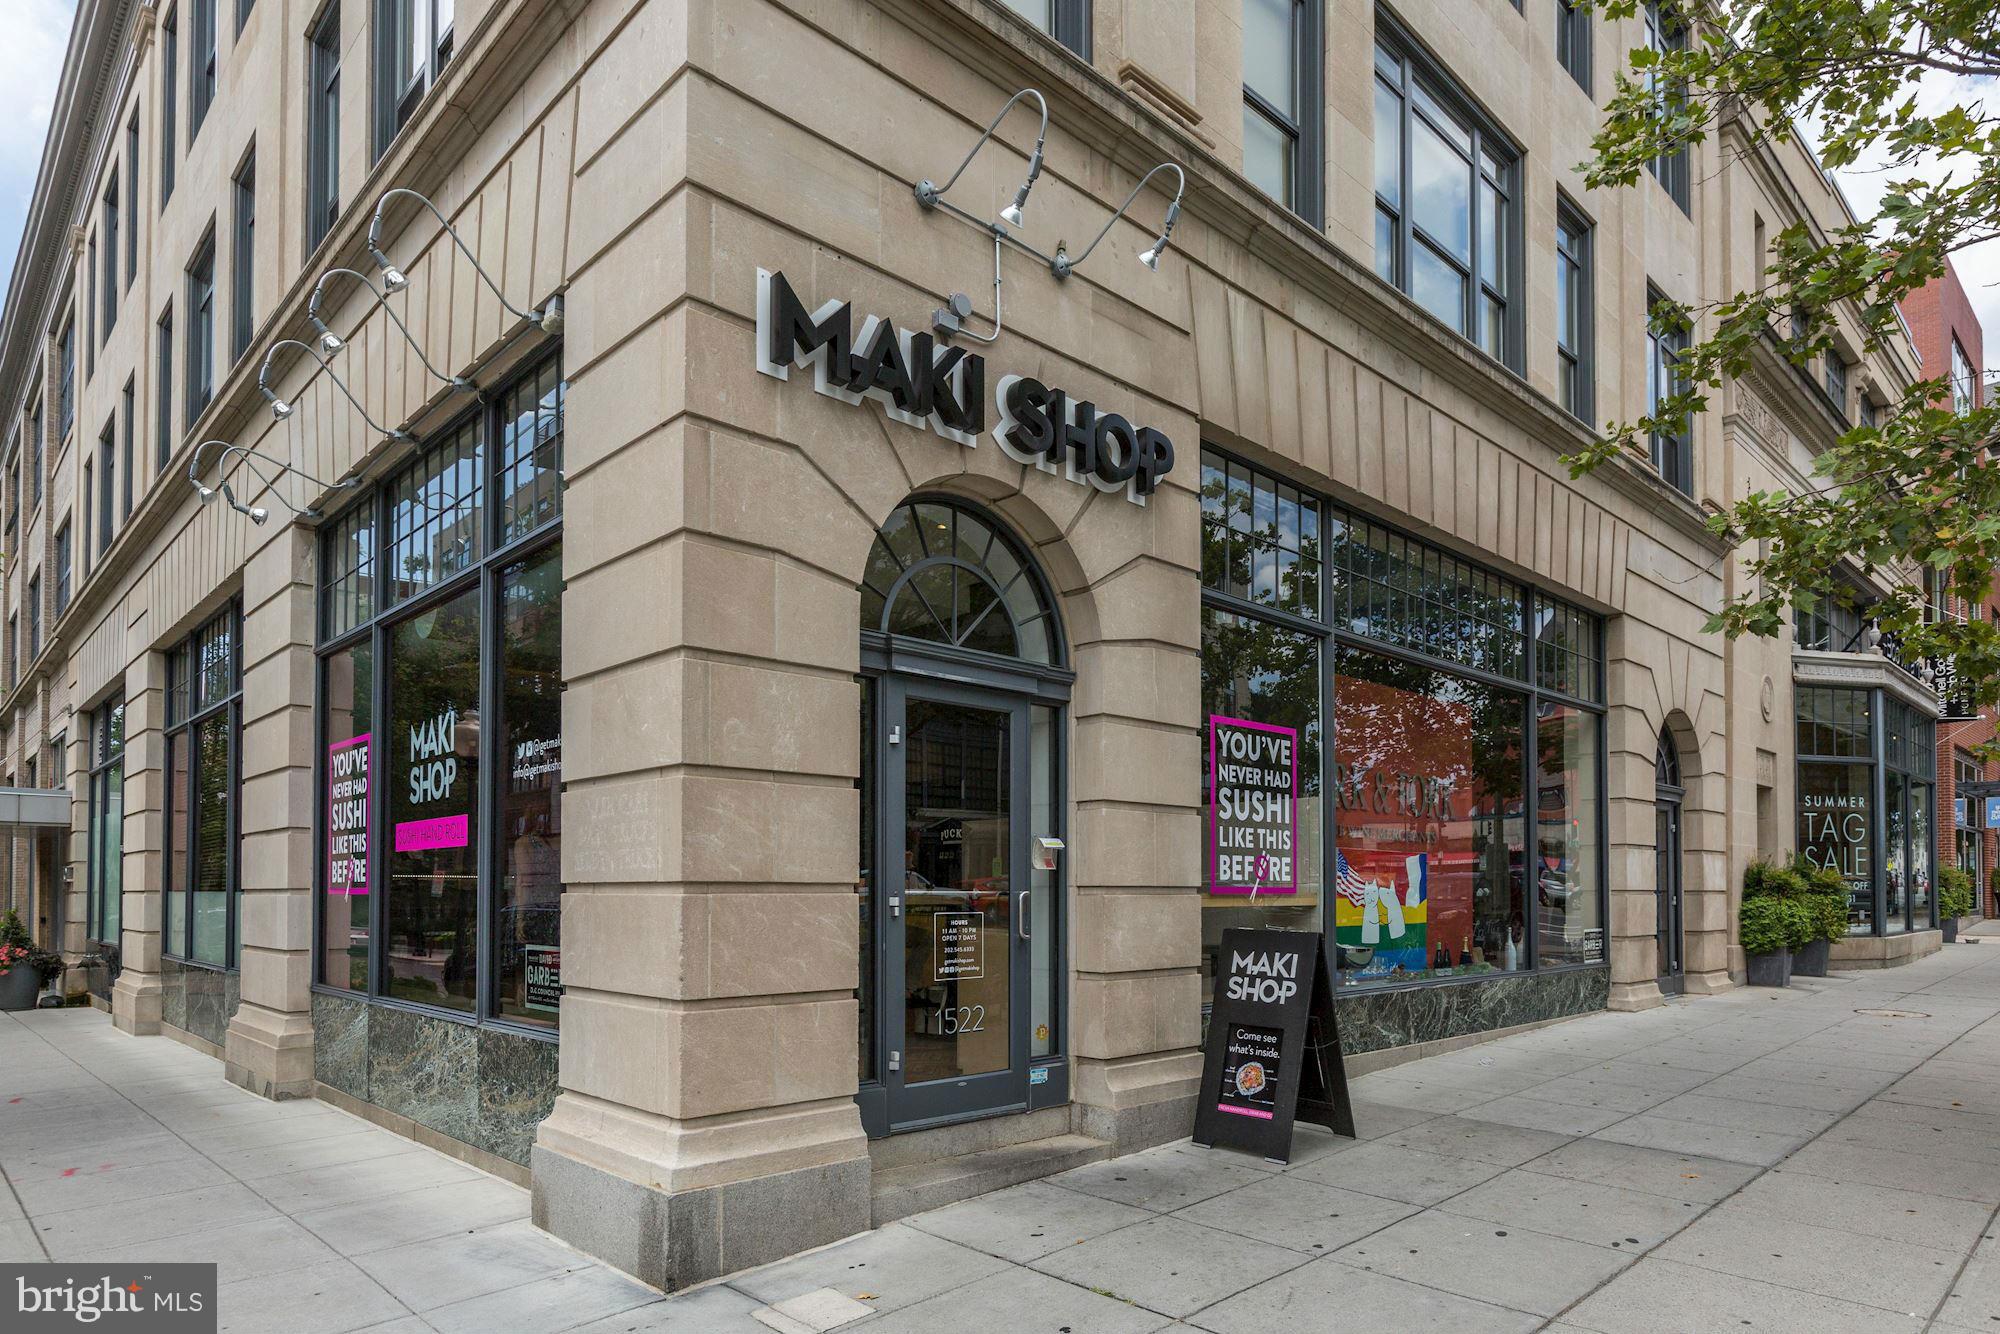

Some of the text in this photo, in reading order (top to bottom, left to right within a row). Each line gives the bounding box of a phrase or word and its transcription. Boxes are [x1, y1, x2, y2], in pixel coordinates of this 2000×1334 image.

[757, 267, 1174, 507] MAKI SHOP
[410, 710, 455, 762] MAKI
[1217, 729, 1291, 765] YOU'VE
[333, 746, 367, 777] YOU'VE
[333, 778, 367, 799] NEVER HAD
[409, 758, 457, 804] SHOP
[1218, 764, 1291, 789] NEVER HAD
[332, 798, 366, 831] SUSHI
[1218, 787, 1290, 824] SUSHI
[1805, 795, 1865, 808] SUMMER
[1219, 826, 1291, 850] LIKE THIS
[1804, 813, 1866, 842] TAG
[332, 833, 366, 854] LIKE THIS
[1805, 846, 1867, 876] SALE
[1853, 881, 1868, 890] OFF
[527, 965, 560, 987] GARBE
[1231, 950, 1299, 979] MAKI
[1226, 976, 1297, 1005] SHOP
[935, 1005, 985, 1036] 1522
[1236, 1028, 1277, 1044] Come see
[1228, 1043, 1280, 1059] what's inside.
